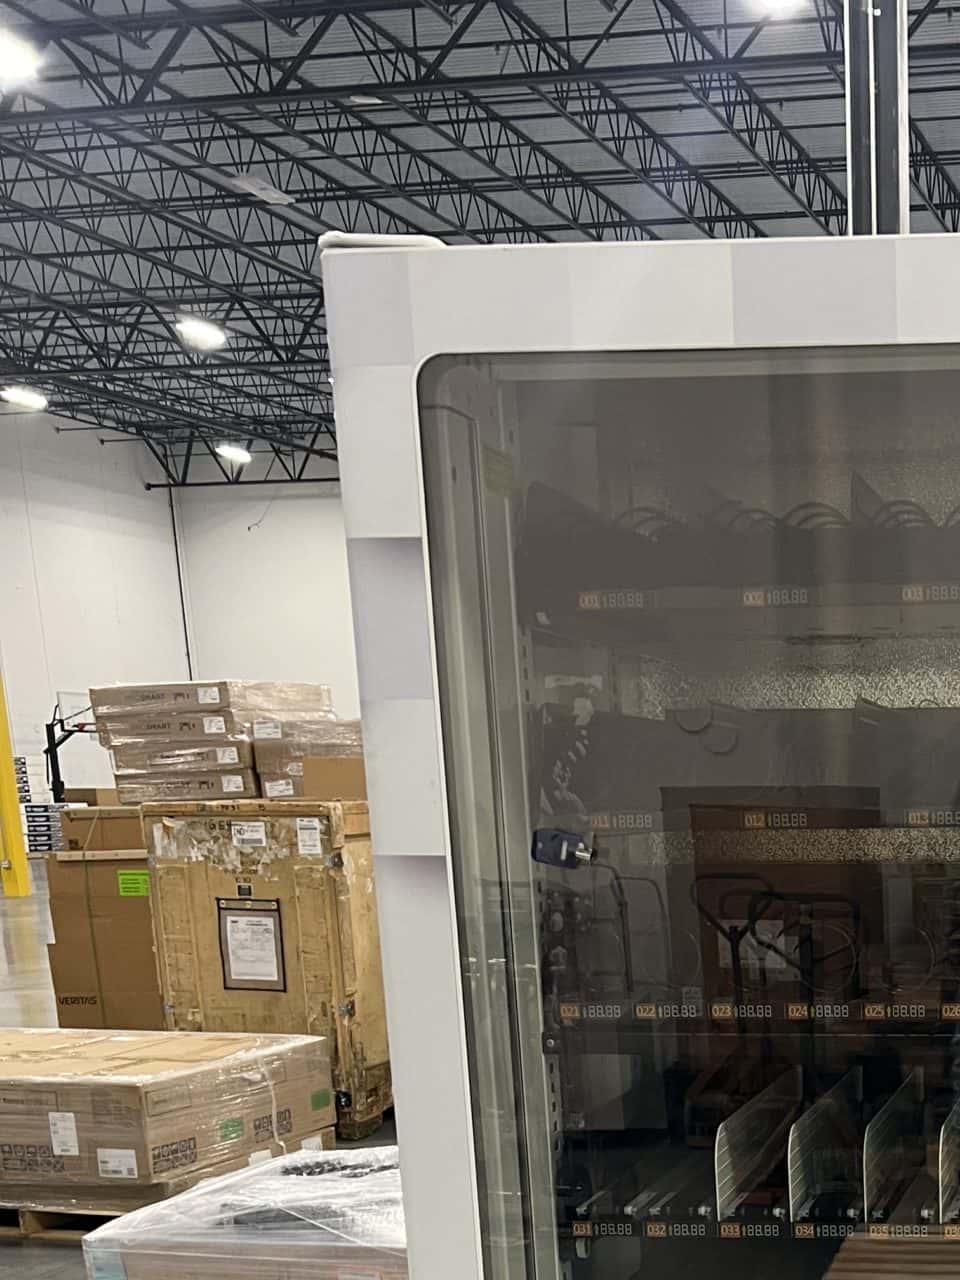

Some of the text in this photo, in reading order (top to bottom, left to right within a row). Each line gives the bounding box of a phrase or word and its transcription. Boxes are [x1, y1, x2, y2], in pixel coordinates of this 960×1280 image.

[560, 1006, 580, 1017] 021
[636, 1006, 655, 1017] 022
[712, 1006, 731, 1017] 023
[788, 1006, 808, 1017] 024
[865, 1006, 884, 1017] 025
[942, 1006, 960, 1017] 026
[573, 1224, 591, 1235] 031
[648, 1225, 666, 1236] 032
[721, 1225, 740, 1236] 033
[795, 1225, 814, 1237] 034
[869, 1225, 888, 1237] 035
